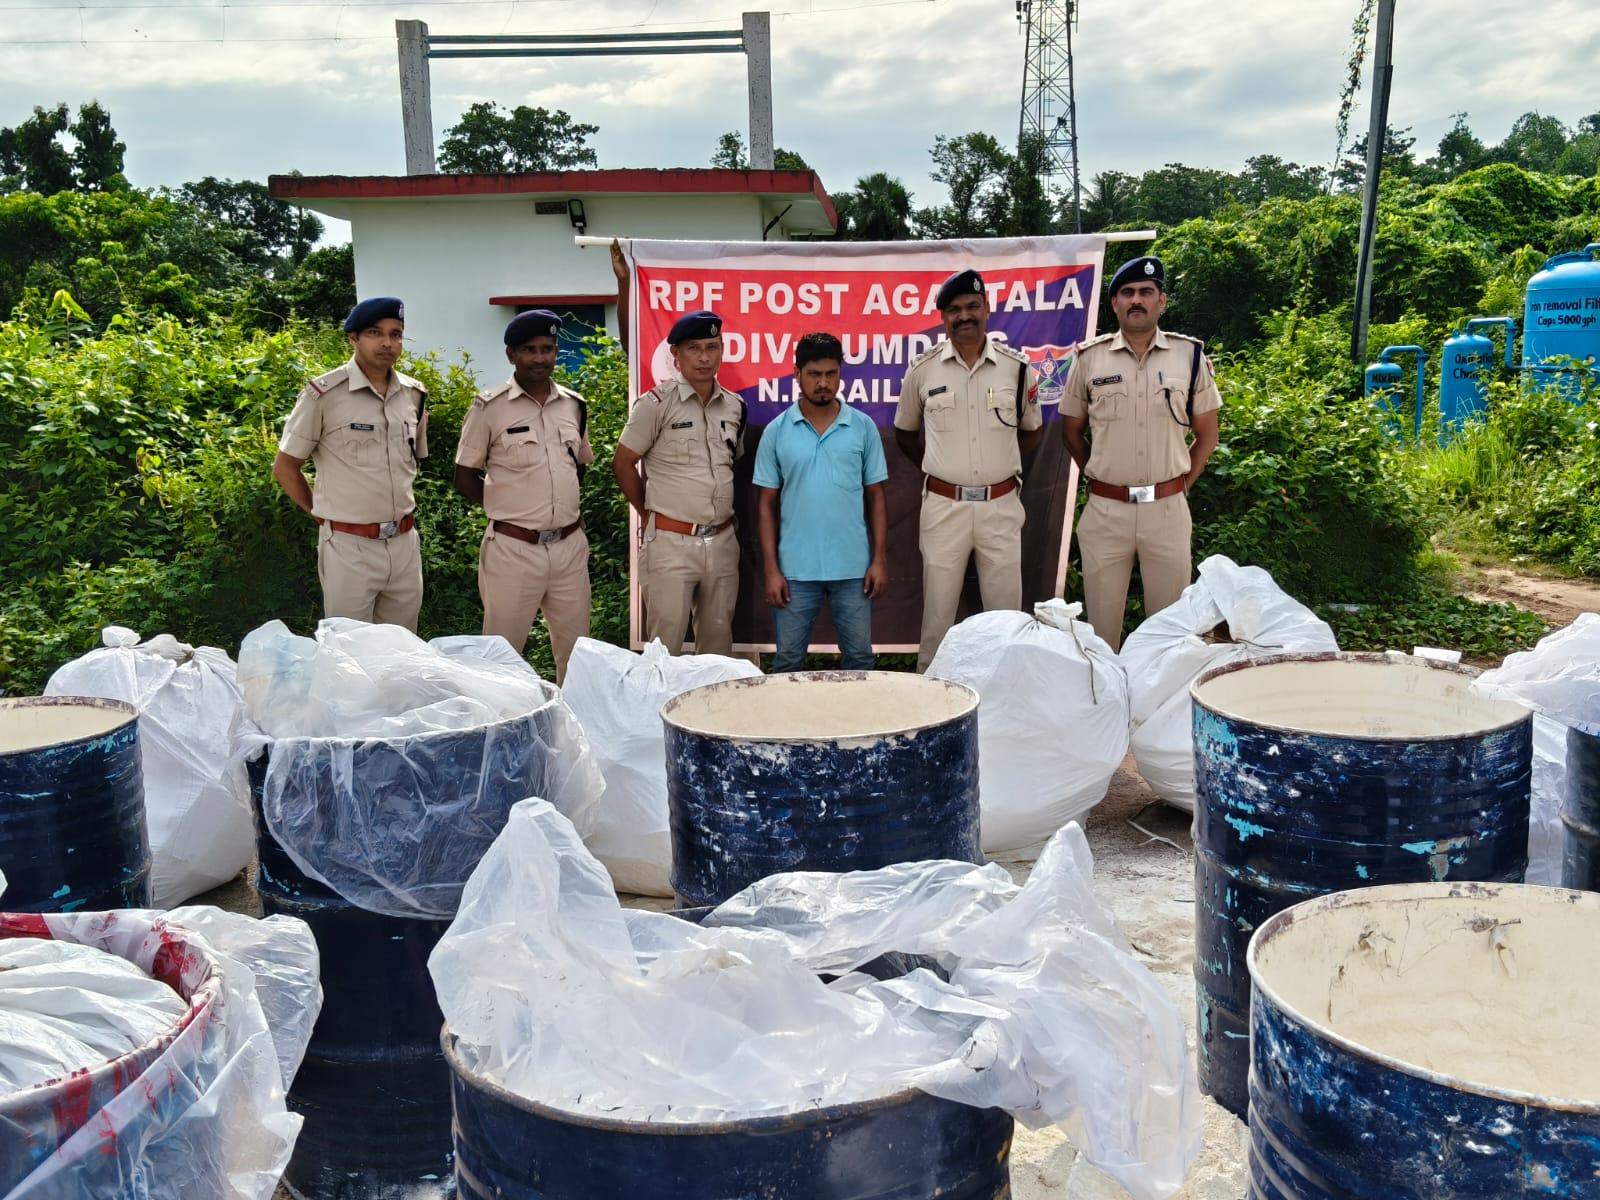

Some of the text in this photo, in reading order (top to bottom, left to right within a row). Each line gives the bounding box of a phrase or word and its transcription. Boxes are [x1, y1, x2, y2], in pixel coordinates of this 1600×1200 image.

[649, 278, 1084, 315] RPF POST AGATALA
[1544, 299, 1581, 311] removal
